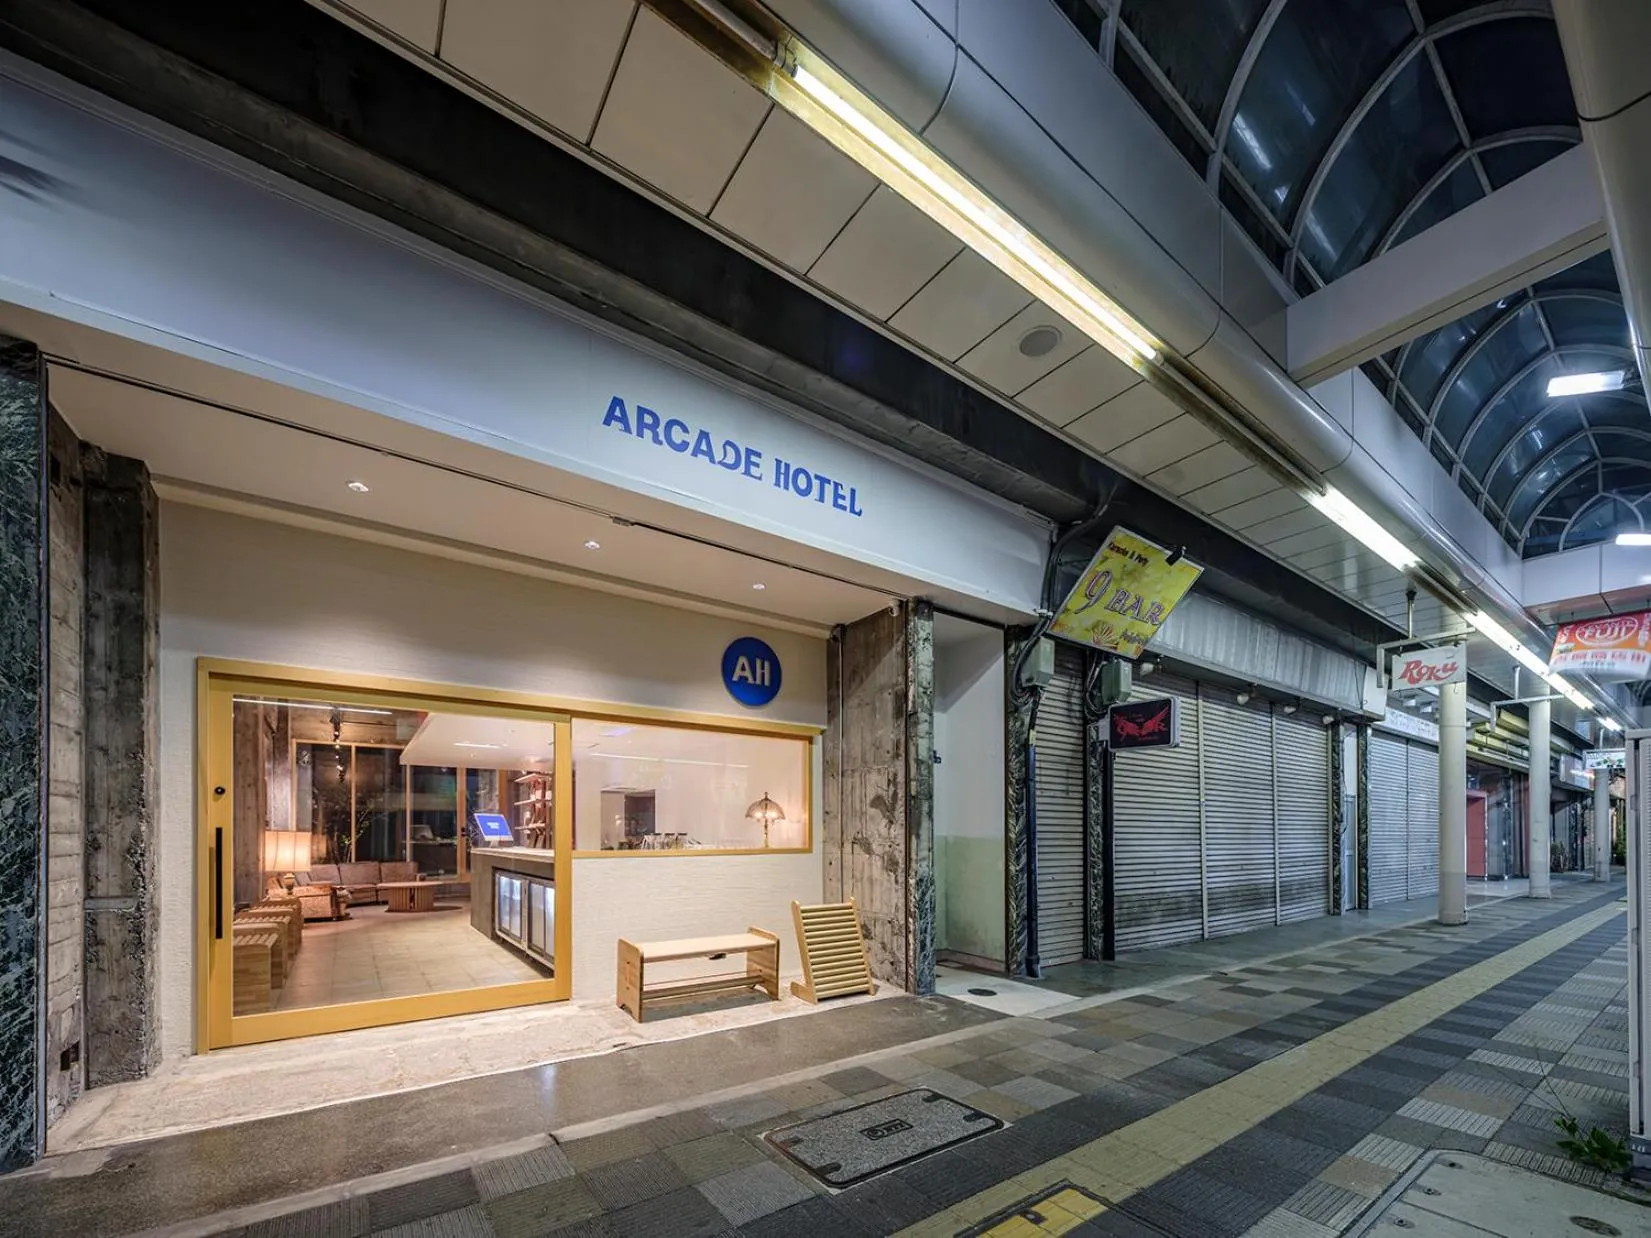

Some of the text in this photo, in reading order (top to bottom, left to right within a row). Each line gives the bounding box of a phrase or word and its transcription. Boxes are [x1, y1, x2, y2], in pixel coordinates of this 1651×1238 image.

[602, 395, 863, 517] ARCADE HOTEL
[1074, 570, 1165, 625] 9 BAR
[731, 655, 771, 687] AH
